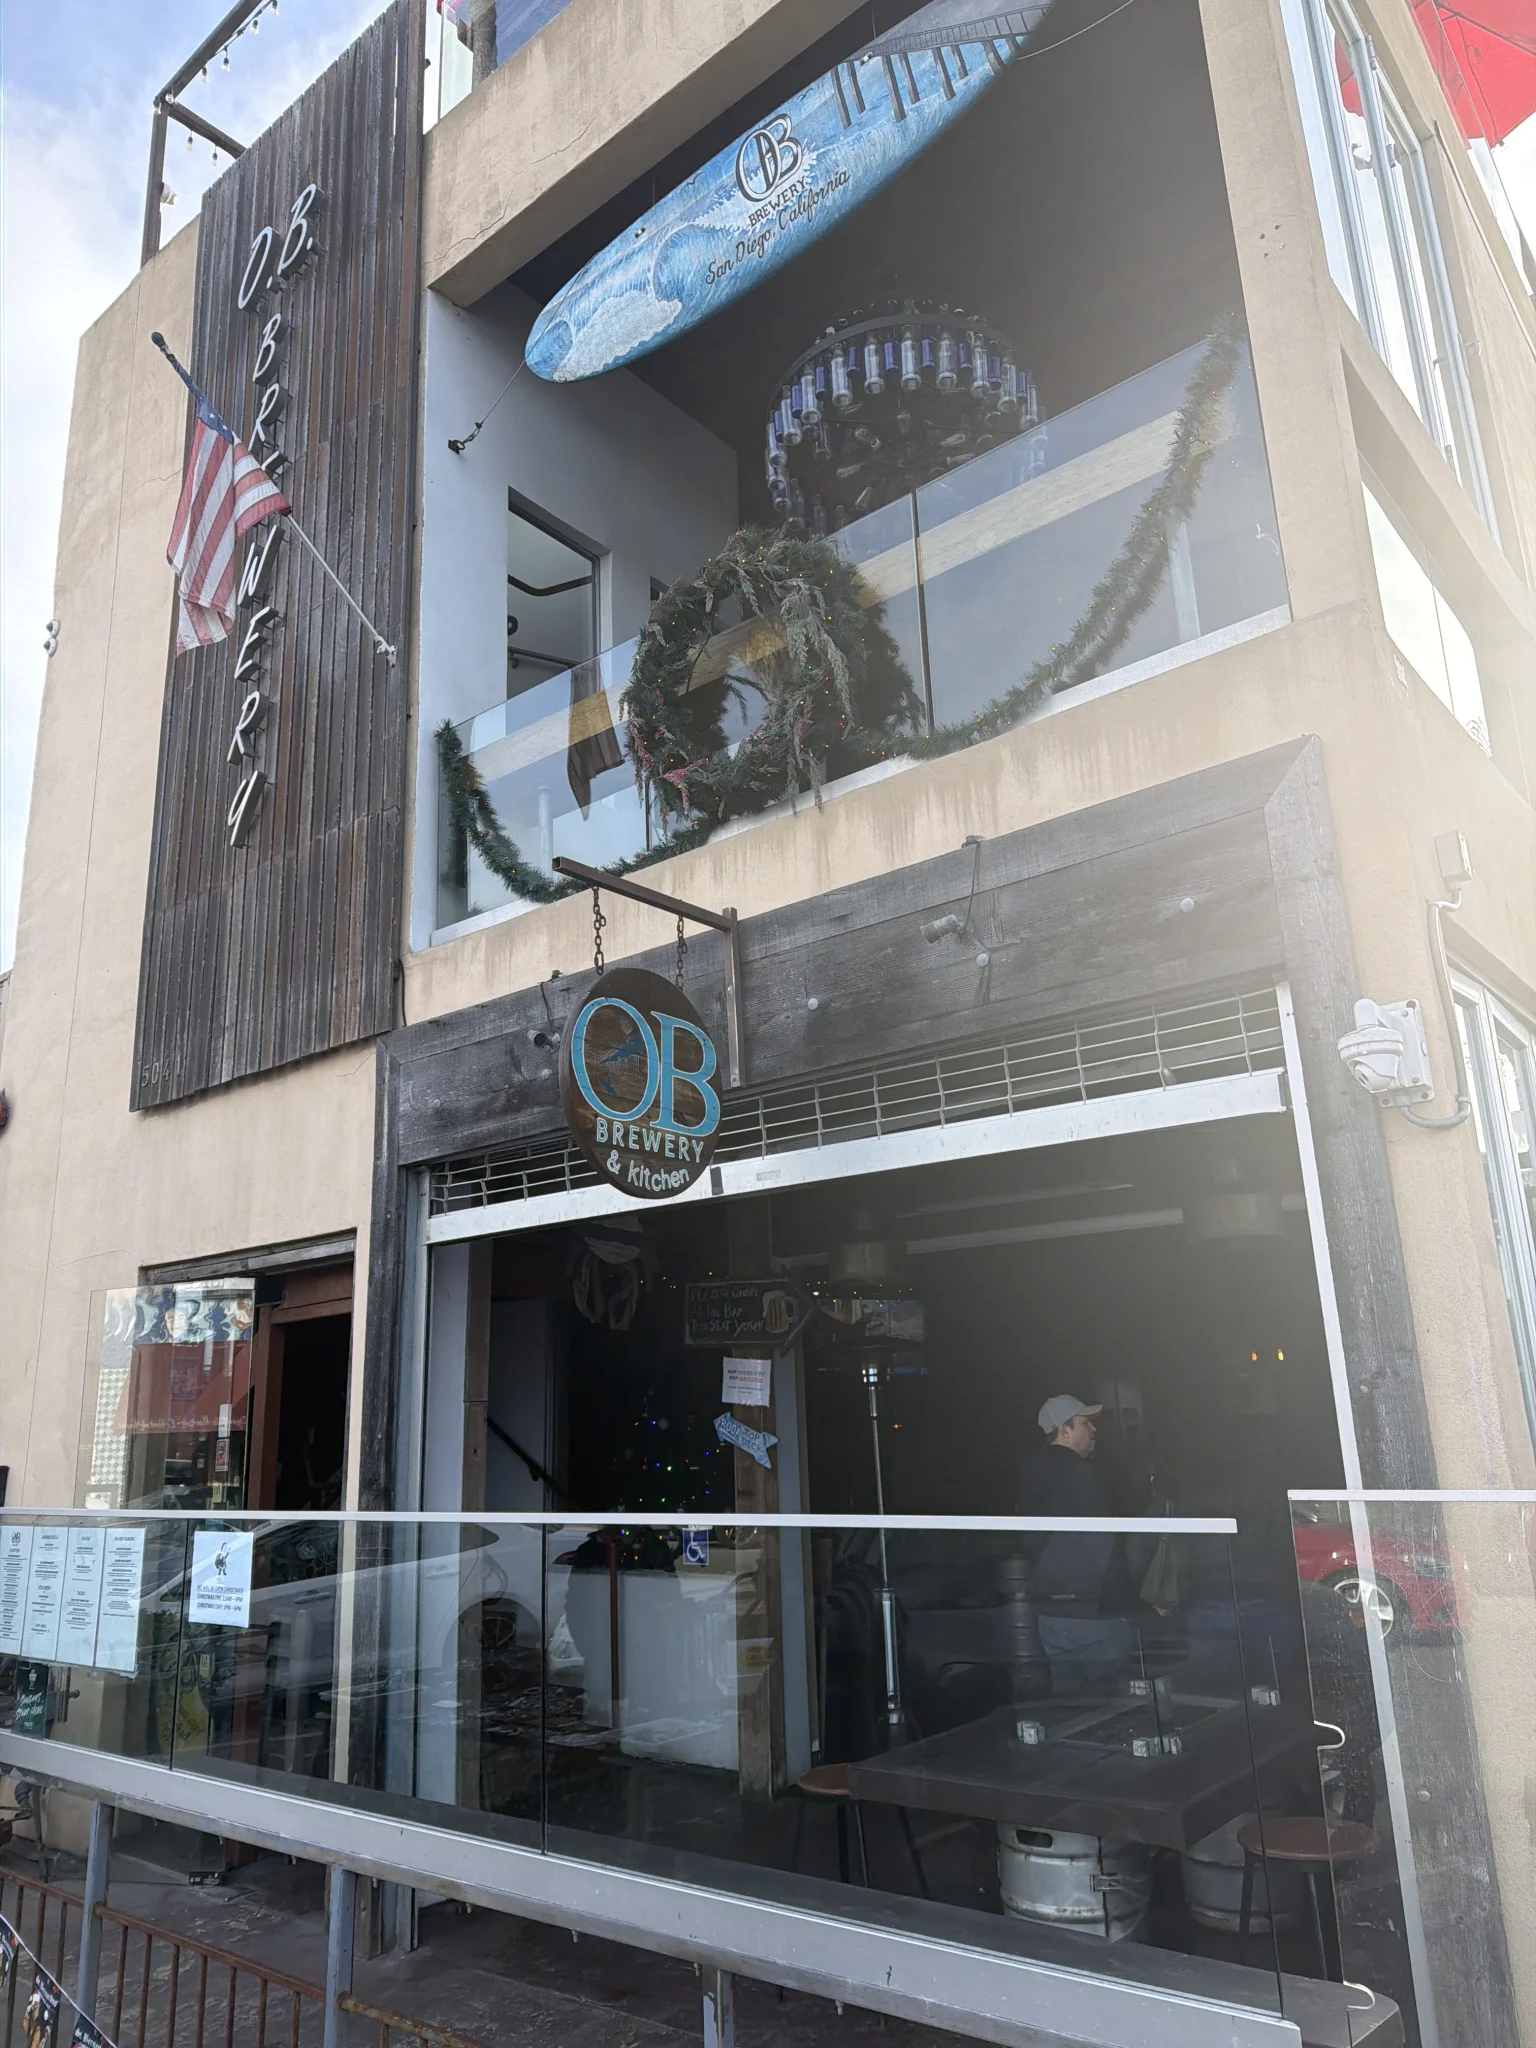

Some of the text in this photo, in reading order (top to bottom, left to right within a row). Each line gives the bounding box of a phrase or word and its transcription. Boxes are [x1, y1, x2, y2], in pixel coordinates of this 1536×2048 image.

[735, 113, 803, 203] OB
[705, 259, 735, 285] San
[778, 168, 851, 231] California
[747, 176, 807, 229] BREWERY
[140, 1054, 182, 1088] 5041
[571, 997, 720, 1137] OB
[596, 1117, 705, 1164] BREWERY
[720, 1418, 741, 1438] ROOF
[743, 1428, 760, 1441] TOP
